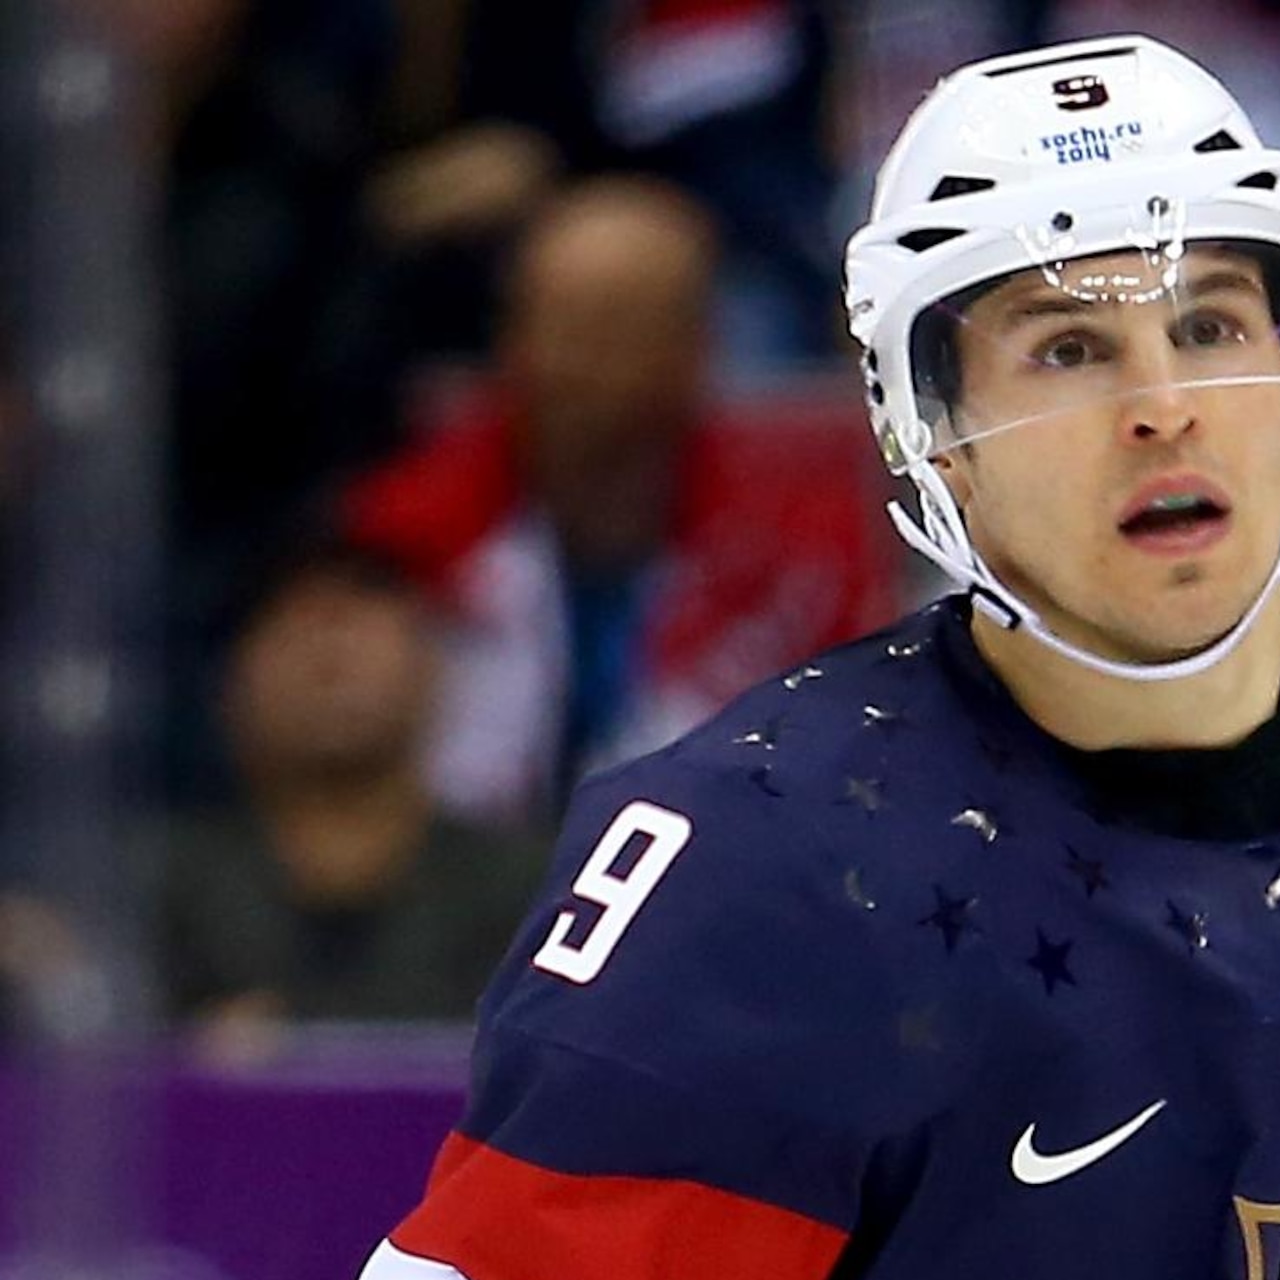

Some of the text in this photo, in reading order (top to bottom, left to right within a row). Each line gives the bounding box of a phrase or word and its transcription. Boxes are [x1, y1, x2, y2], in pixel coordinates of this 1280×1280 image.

[1039, 121, 1142, 150] sochi.ru
[1056, 142, 1111, 164] 2014
[532, 799, 694, 984] 9
